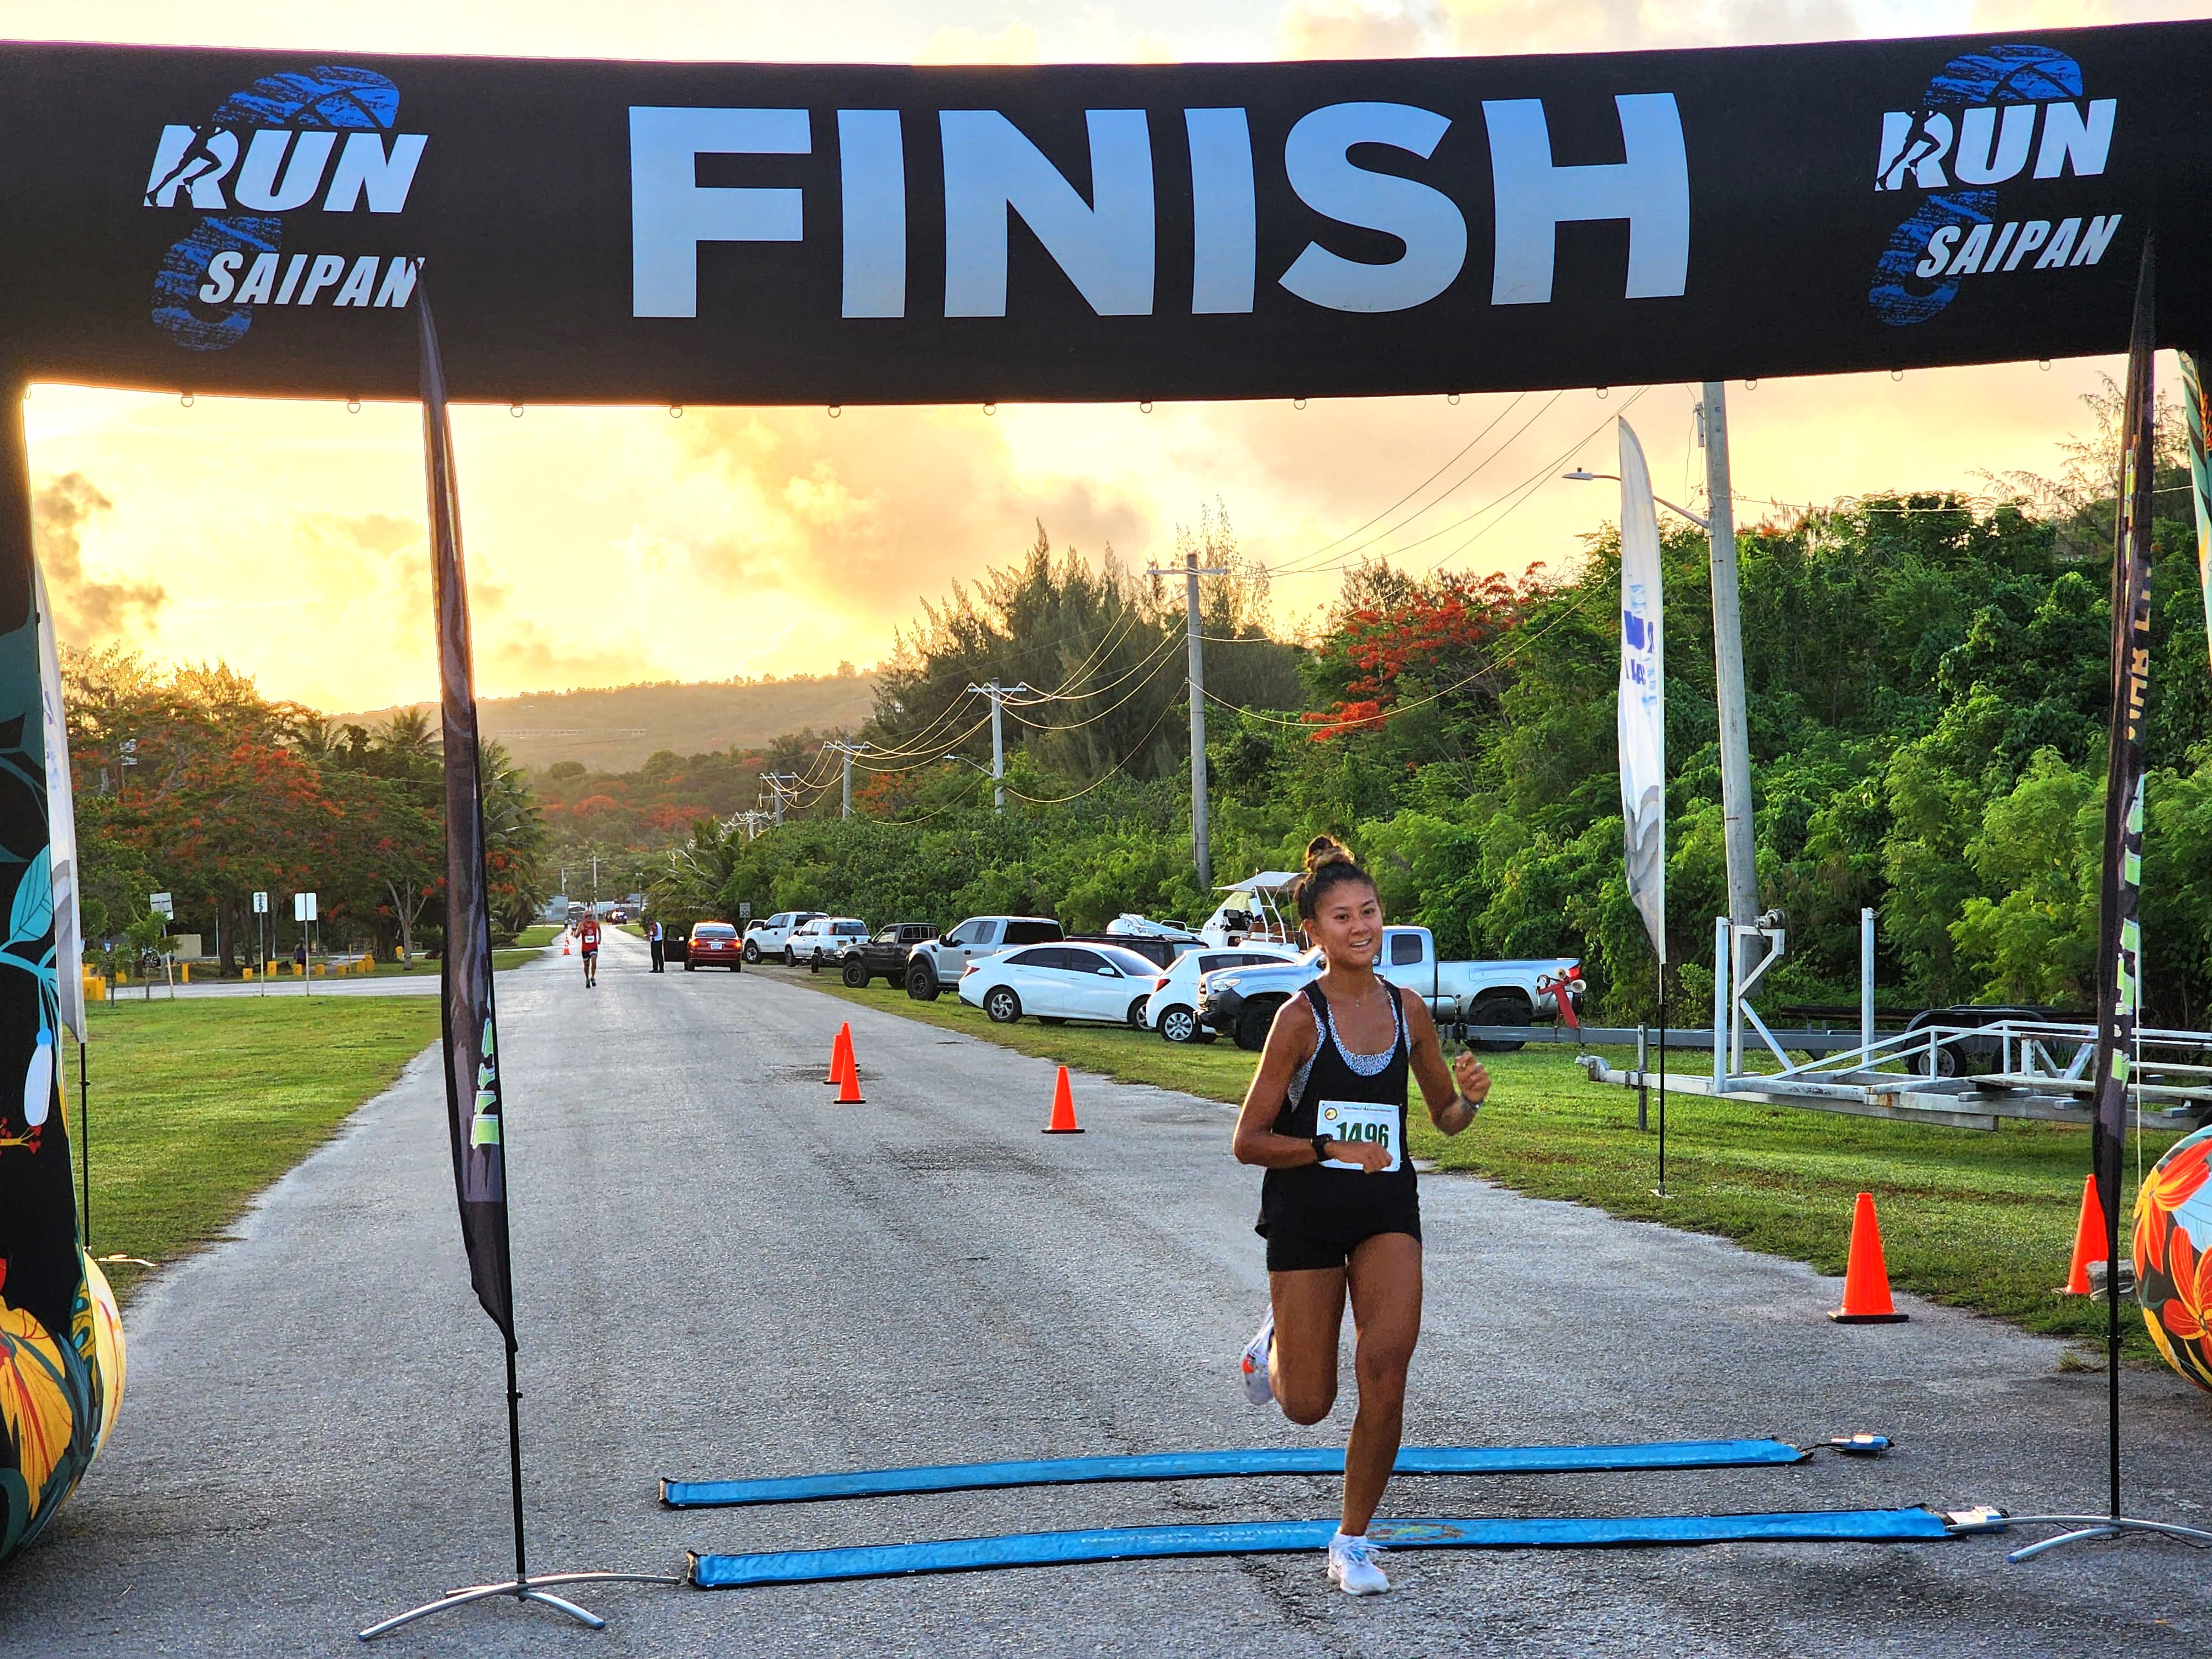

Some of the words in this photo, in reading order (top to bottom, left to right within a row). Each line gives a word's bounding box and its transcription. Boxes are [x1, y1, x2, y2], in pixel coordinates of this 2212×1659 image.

[144, 124, 429, 213] RUN
[1875, 98, 2117, 191] RUN
[629, 93, 1689, 318] FINISH
[199, 251, 425, 308] SAIPAN
[1916, 214, 2122, 278] SAIPAN
[1337, 1122, 1389, 1150] 1496
